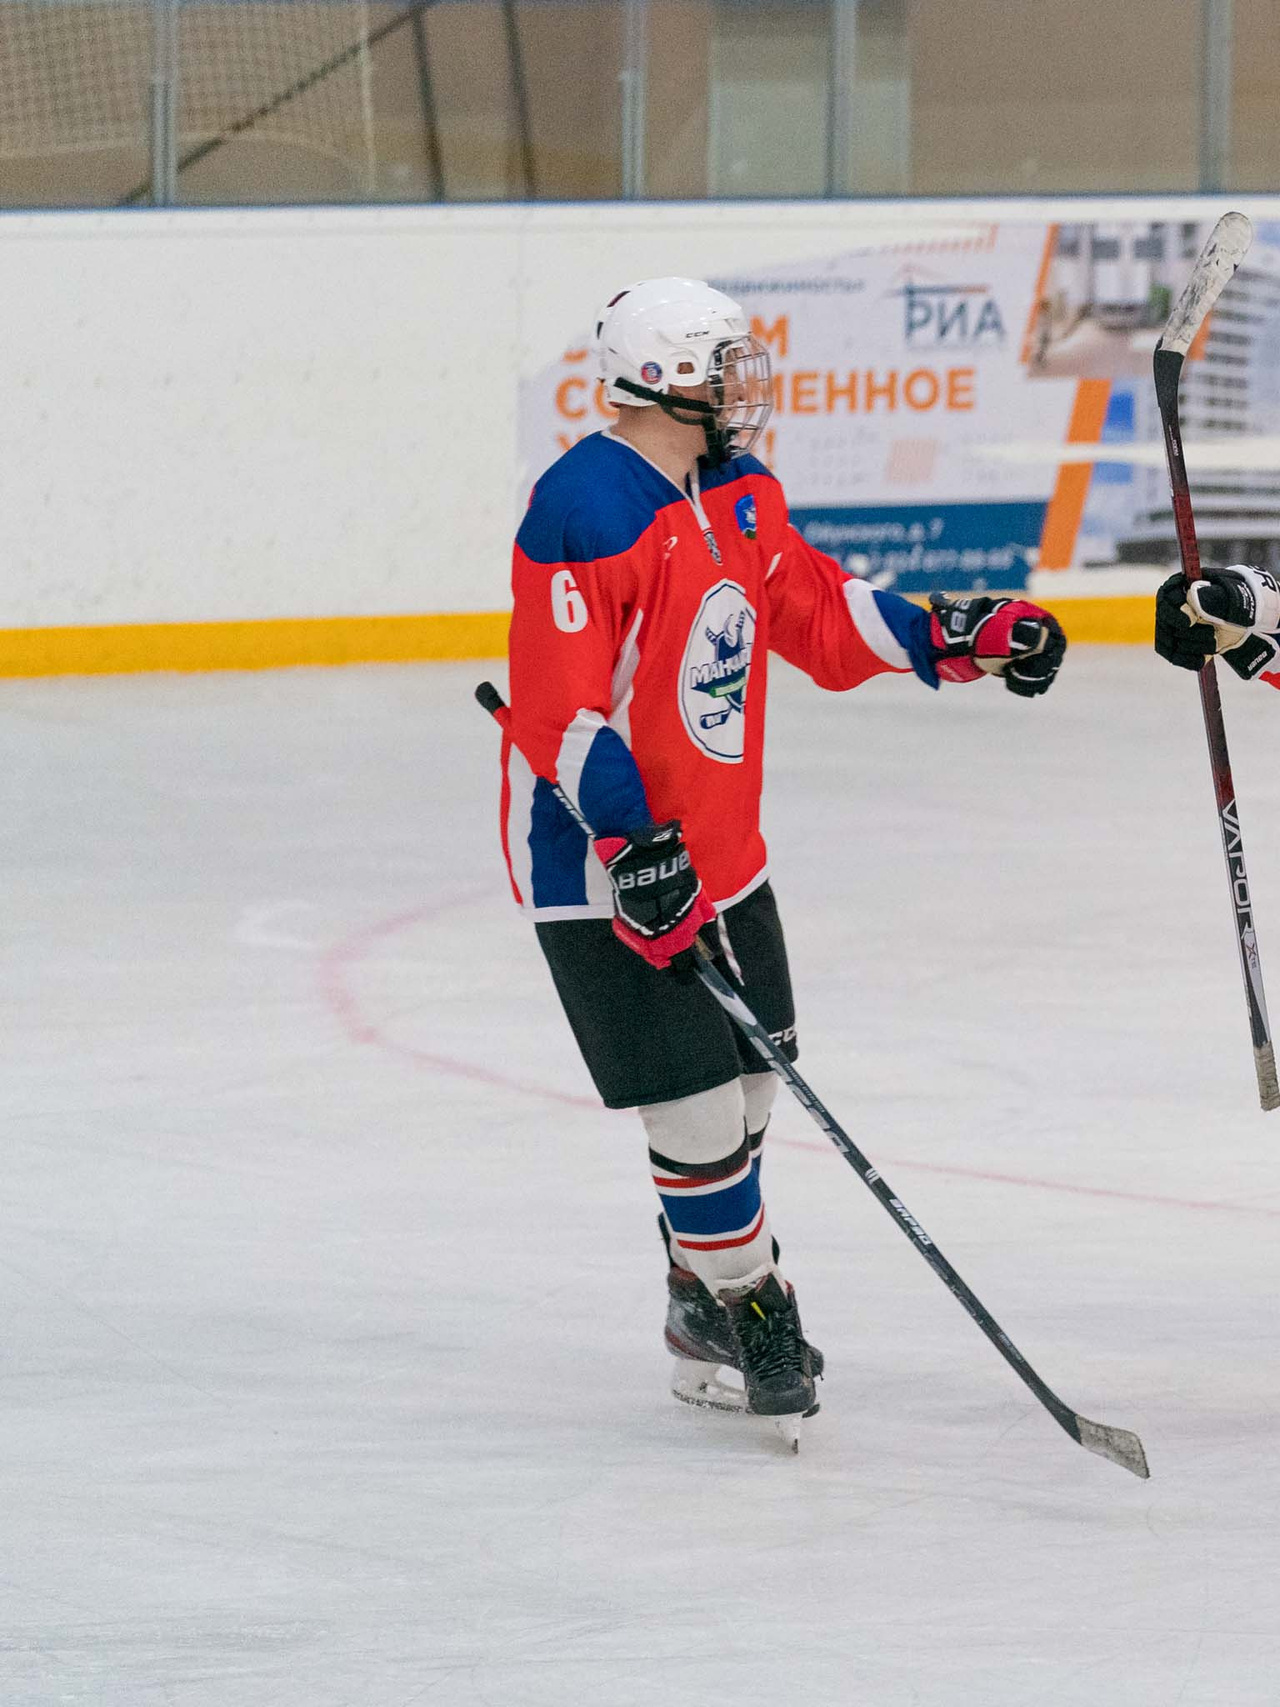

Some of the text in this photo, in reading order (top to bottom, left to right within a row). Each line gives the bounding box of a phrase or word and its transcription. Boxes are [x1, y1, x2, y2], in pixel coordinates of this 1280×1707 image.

[903, 299, 1006, 339] РИА
[550, 570, 588, 633] 6
[619, 851, 690, 889] BAUE
[1222, 799, 1253, 940] VAPOR
